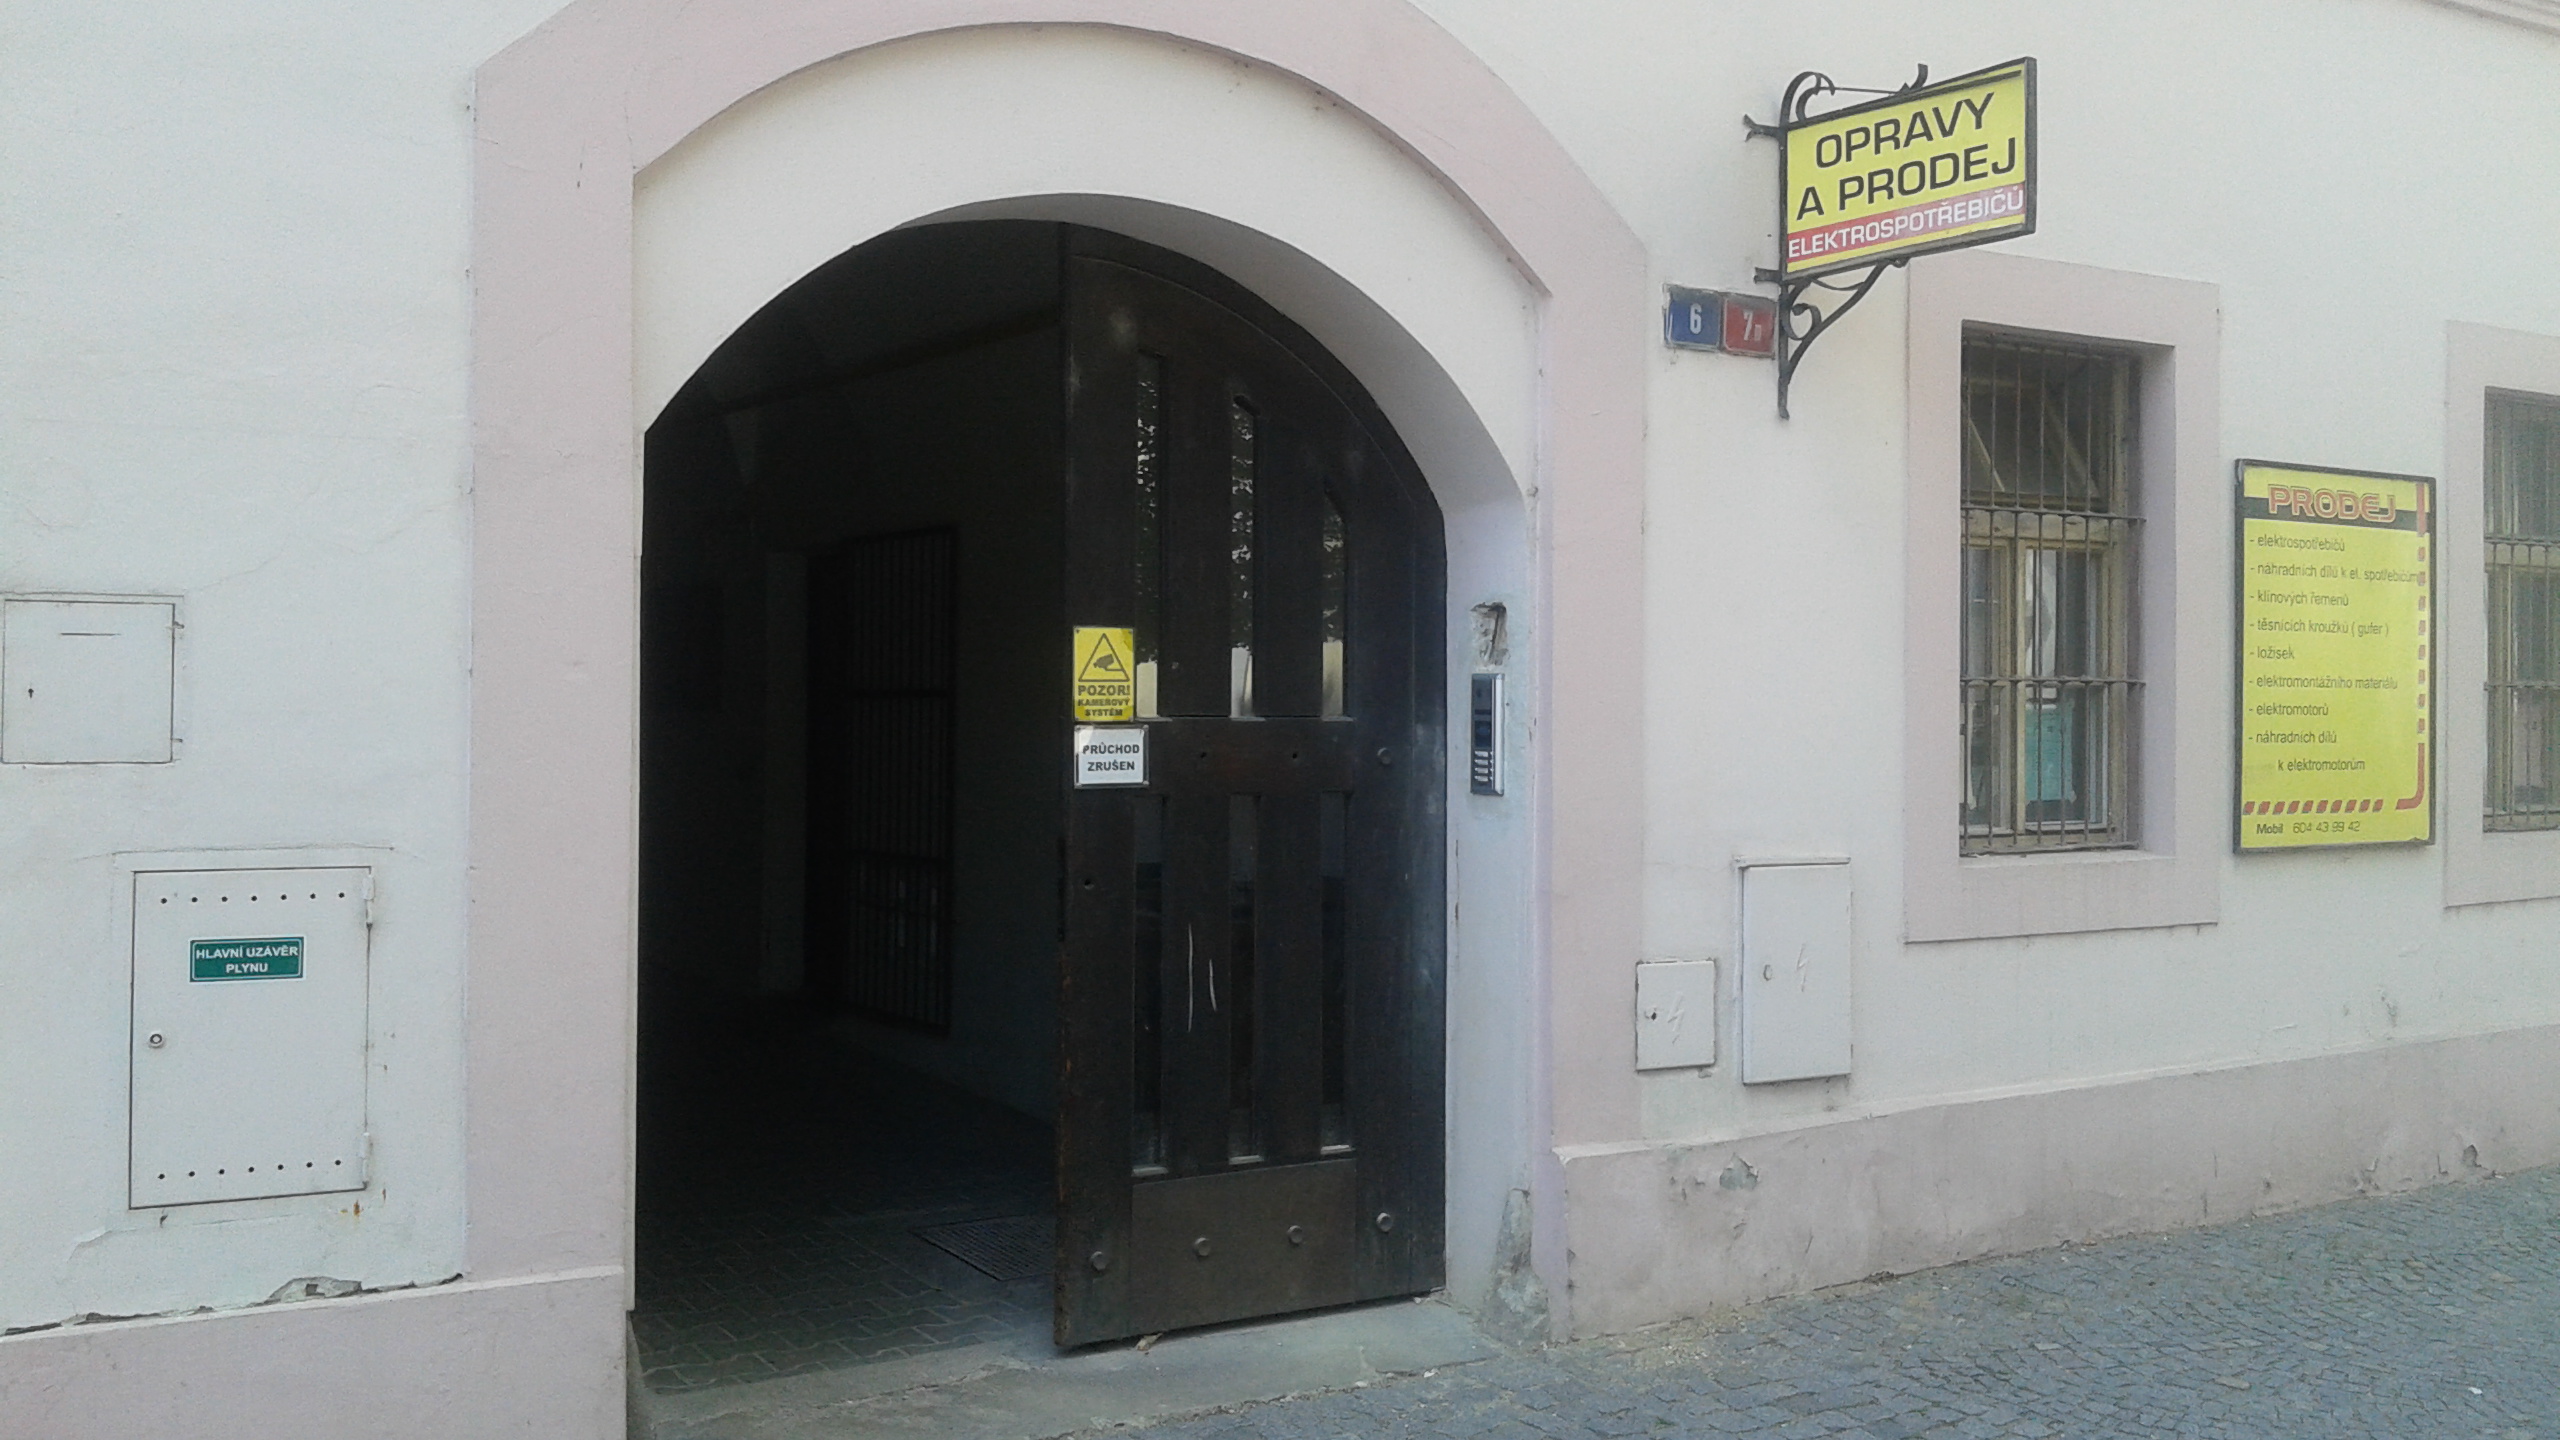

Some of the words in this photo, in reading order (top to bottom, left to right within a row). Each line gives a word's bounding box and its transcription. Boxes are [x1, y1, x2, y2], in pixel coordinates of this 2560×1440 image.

[1816, 92, 1995, 169] OPRAVY
[1796, 186, 1825, 221] A
[1839, 137, 2017, 211] PRODEJ
[1788, 186, 2024, 259] ELEKTROSPOTŘEBIČŮ
[1689, 303, 1702, 334] 6
[2267, 484, 2396, 523] PRODEJ
[2257, 644, 2295, 660] ložisek
[1078, 685, 1130, 696] POZOR!
[1085, 708, 1123, 716] SYSTÉM
[2256, 702, 2329, 716] elektromotorů
[2256, 730, 2315, 743] náhradních
[1083, 742, 1140, 754] PRŮCHOD
[1087, 759, 1135, 771] ZRUŠEN
[2278, 760, 2284, 771] k
[2287, 758, 2365, 772] elektromotorům
[2256, 823, 2284, 834] Mobil
[195, 945, 244, 960] HLAVNÍ
[246, 944, 299, 958] UZÁVĚR
[225, 962, 268, 973] PLYNU
